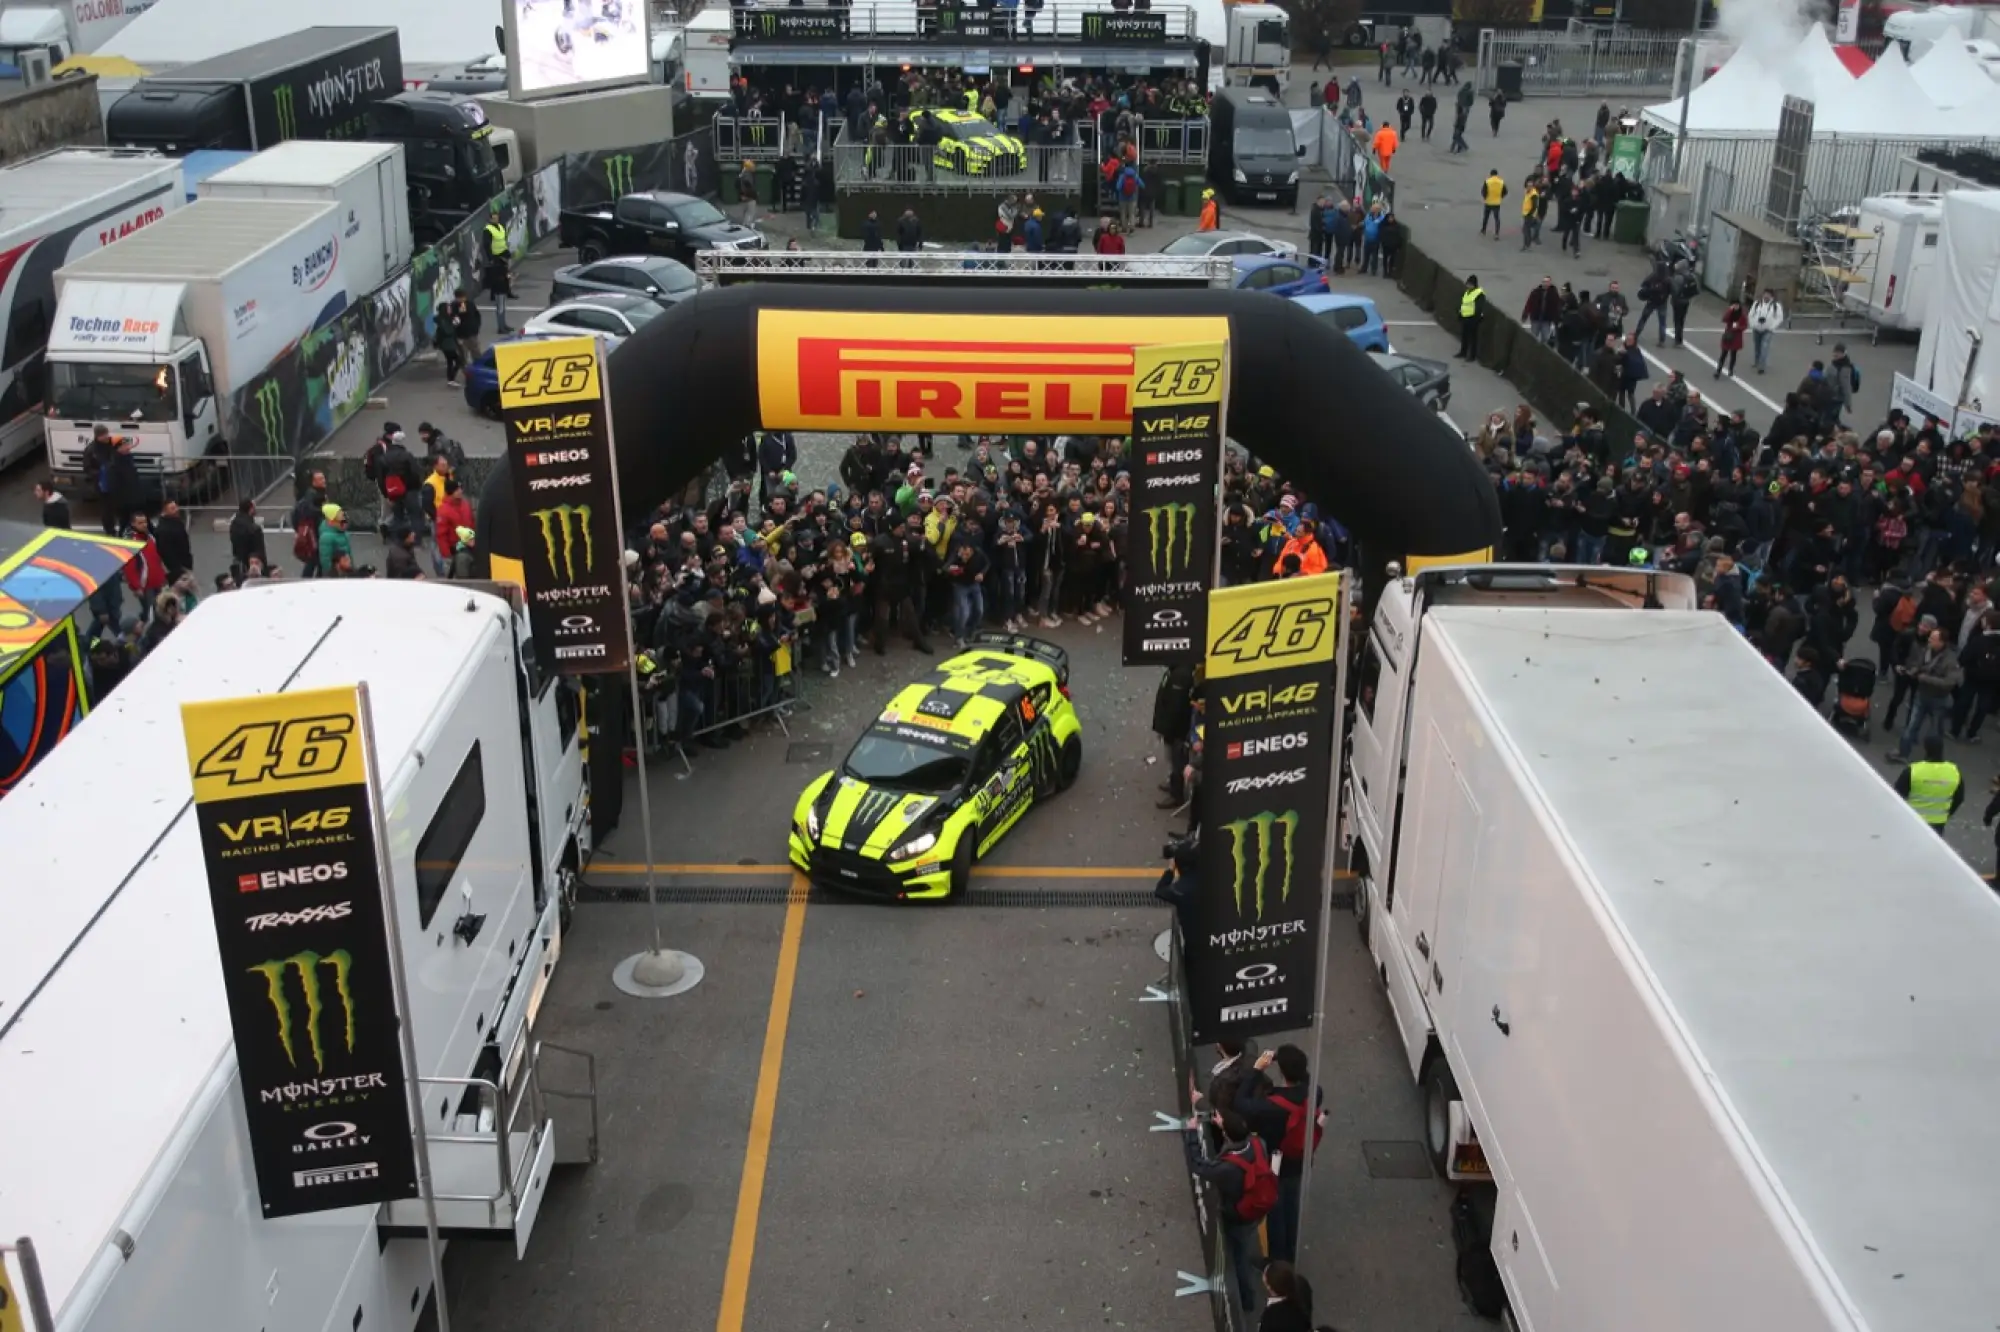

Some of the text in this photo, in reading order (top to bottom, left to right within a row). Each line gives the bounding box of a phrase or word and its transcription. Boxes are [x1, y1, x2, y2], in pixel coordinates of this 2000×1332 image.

[780, 16, 836, 28] MONSTER
[1106, 19, 1162, 30] MONSTER
[307, 57, 385, 117] MONSTER
[70, 316, 159, 334] Techno Race
[503, 354, 593, 398] 46
[798, 337, 1134, 421] PIRELL
[1136, 358, 1221, 399] 46
[538, 448, 590, 465] ENEOS
[1158, 449, 1202, 464] ENEOS
[529, 473, 591, 490] TRAXXAS
[536, 585, 611, 601] MONSTER
[1135, 580, 1202, 596] MONSTER
[555, 626, 601, 635] OAKLEY
[1145, 621, 1188, 629] OAKLEY
[1210, 598, 1333, 664] 46
[555, 643, 606, 660] PIRELLI
[1142, 637, 1190, 651] PIRELLI
[1218, 706, 1318, 728] RACING APPAREL
[195, 713, 355, 786] 46
[1243, 731, 1308, 756] ENEOS
[1226, 767, 1307, 794] TRAXXAS
[221, 834, 356, 858] RACING APPAREL
[260, 861, 348, 889] ENEOS
[245, 901, 353, 932] TRAXXAS
[1209, 919, 1307, 947] MONSTER
[1224, 938, 1292, 955] ENERGY
[1224, 975, 1287, 992] OAKLEY
[1220, 998, 1288, 1022] PIRELLI
[260, 1072, 387, 1103] MONSTER
[284, 1093, 369, 1111] ENERGY
[292, 1135, 371, 1153] OAKLEY
[293, 1161, 379, 1188] PIRELLI
